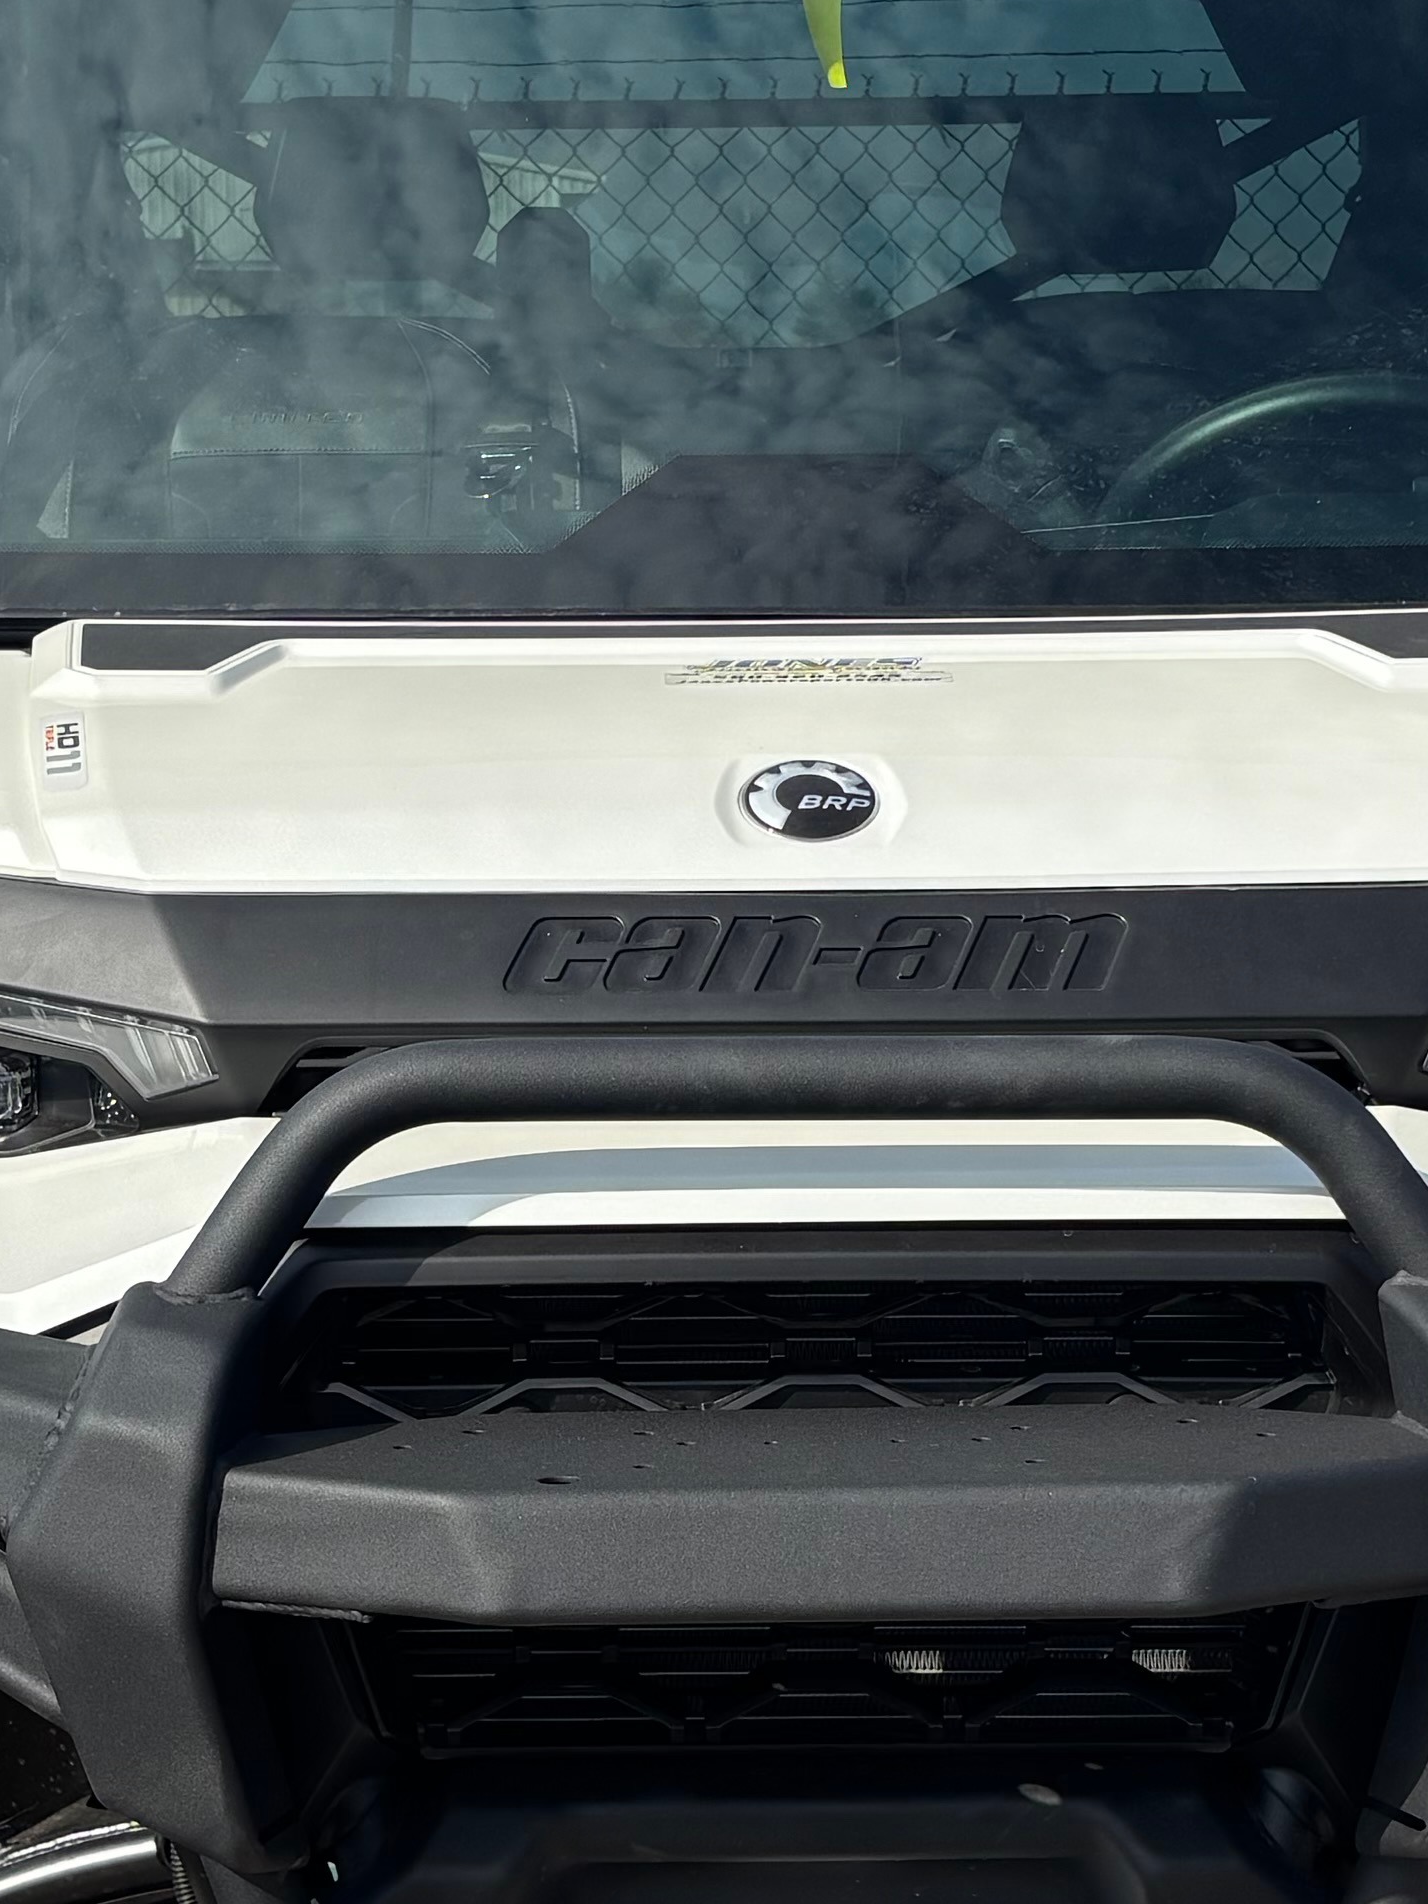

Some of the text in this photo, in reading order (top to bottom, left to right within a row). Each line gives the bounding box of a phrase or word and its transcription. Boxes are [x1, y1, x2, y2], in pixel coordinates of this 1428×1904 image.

[46, 723, 81, 775] HD11
[798, 795, 870, 811] BRP
[503, 915, 1129, 992] can-am
